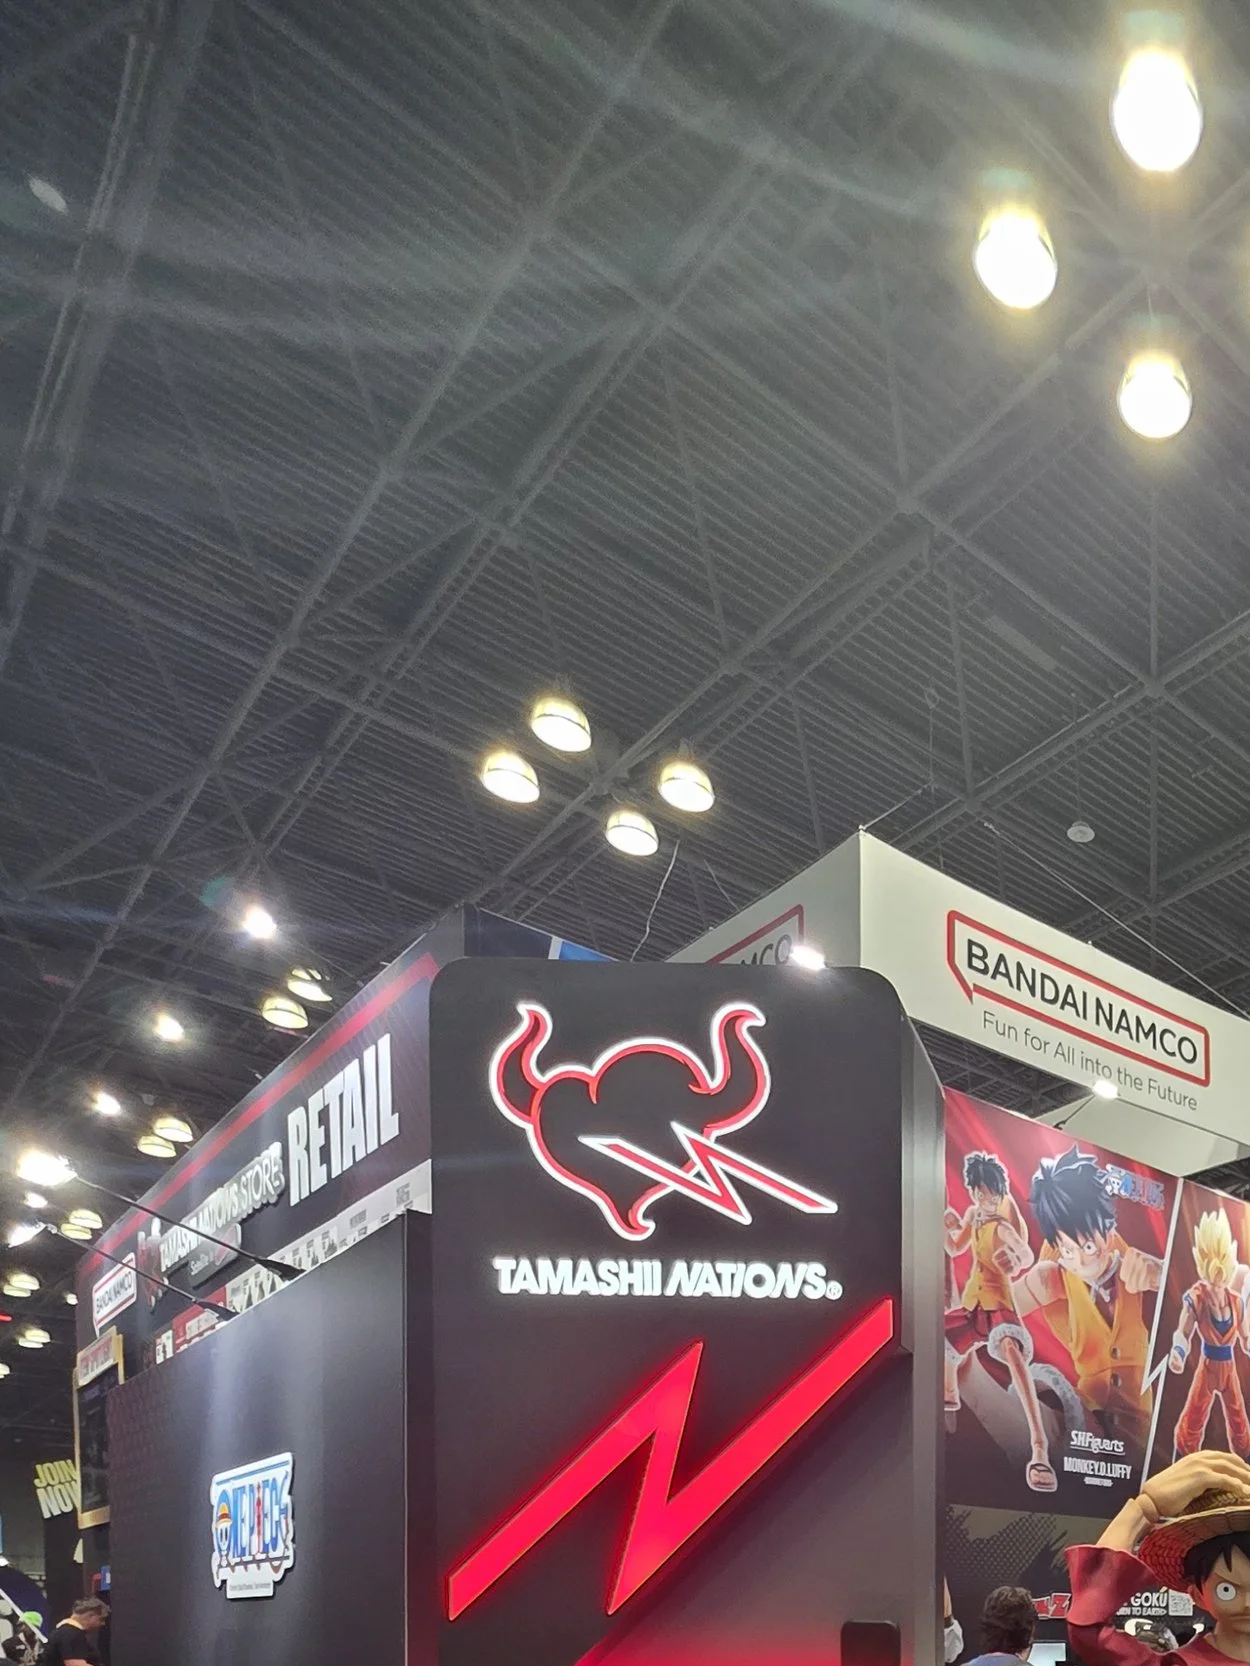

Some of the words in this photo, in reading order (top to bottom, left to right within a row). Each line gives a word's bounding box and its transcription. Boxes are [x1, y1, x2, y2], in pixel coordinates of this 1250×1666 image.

[967, 938, 1088, 1021] BANDAI
[1095, 996, 1198, 1065] NAMCO
[983, 1010, 1018, 1042] Fun
[1024, 1027, 1050, 1054] for
[1053, 1042, 1075, 1066] All
[1080, 1051, 1112, 1080] into
[1117, 1067, 1144, 1091] the
[1148, 1079, 1198, 1110] Future
[287, 1033, 400, 1207] RETAIL
[494, 1257, 662, 1298] TAMASHII
[34, 1459, 79, 1488] JOIN
